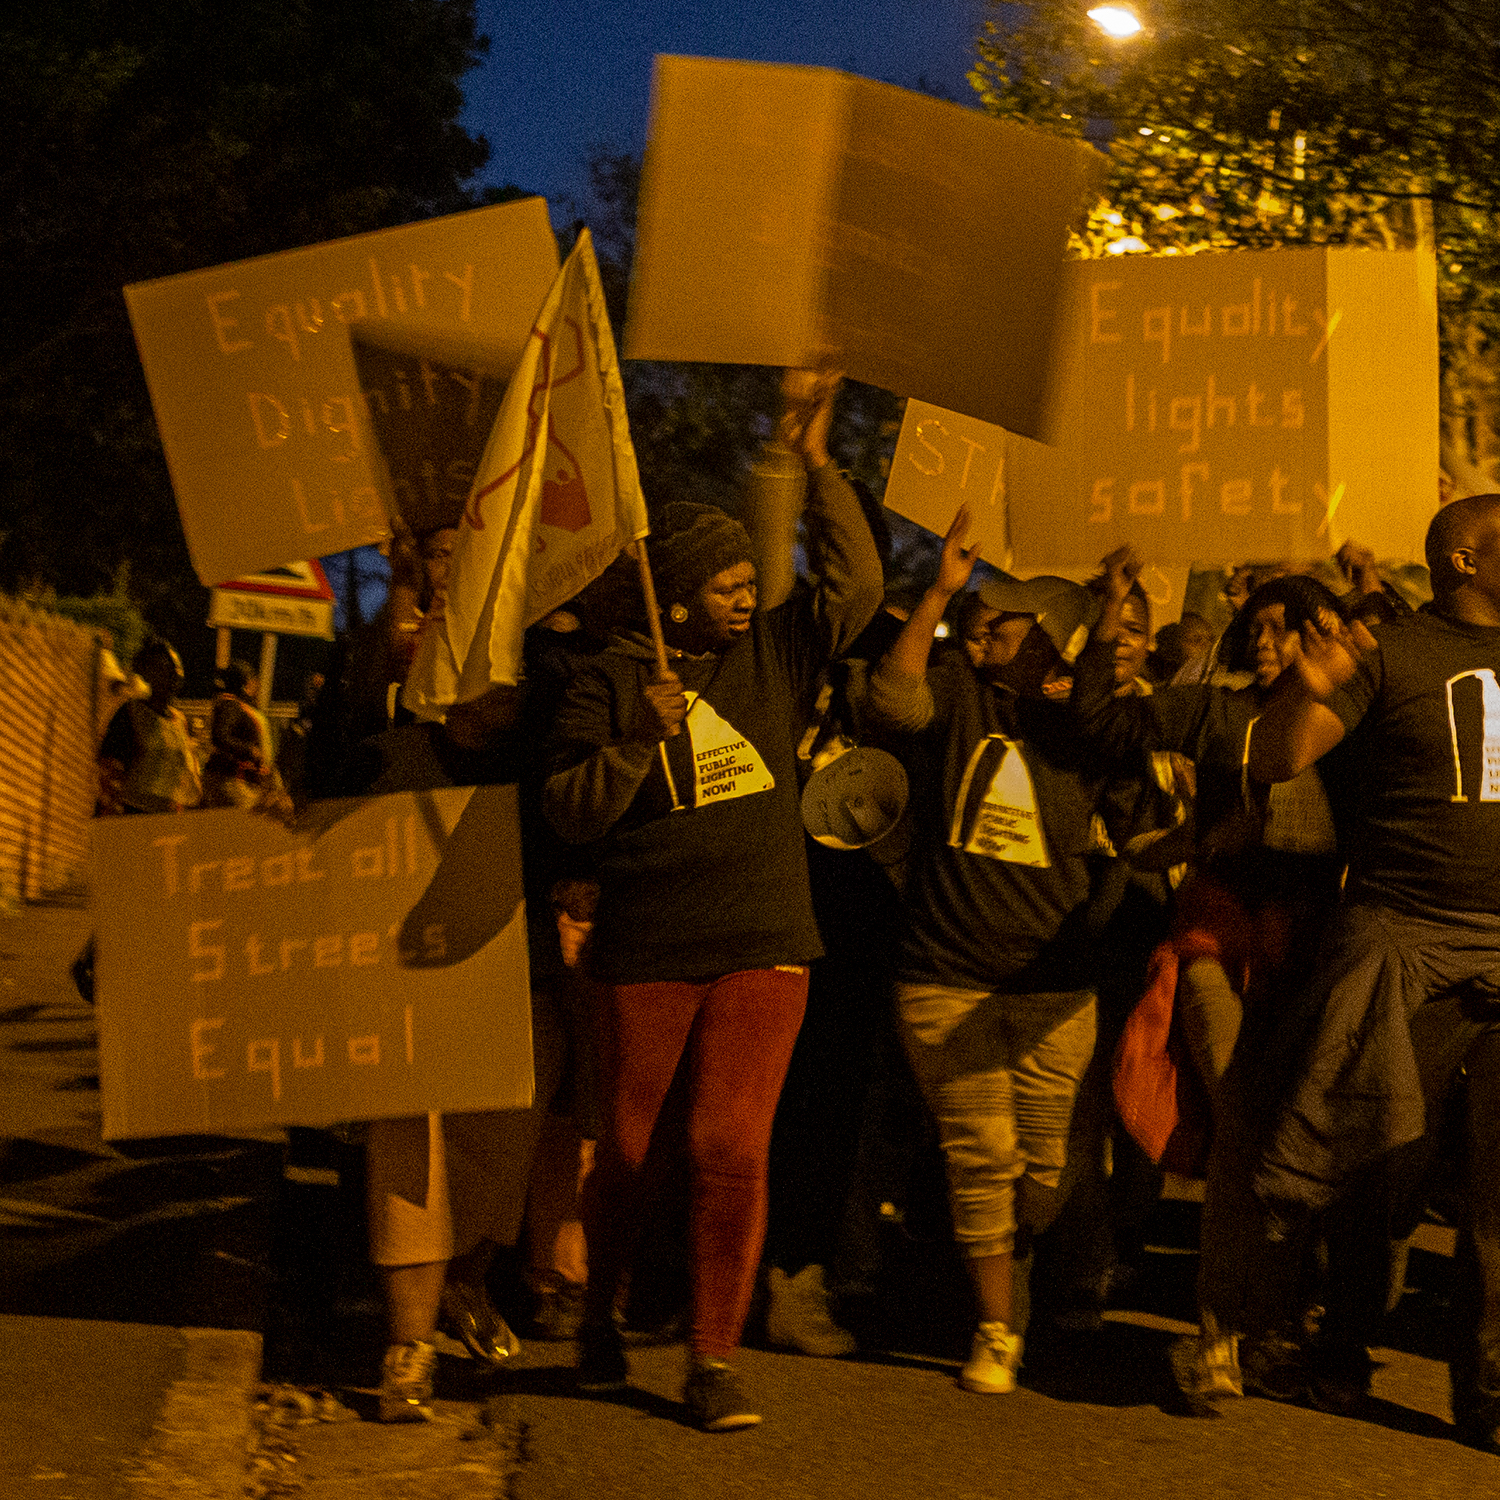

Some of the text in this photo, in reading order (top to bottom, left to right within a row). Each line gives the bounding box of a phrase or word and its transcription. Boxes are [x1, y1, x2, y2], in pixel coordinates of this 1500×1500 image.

[207, 258, 474, 362] Equality
[1091, 276, 1342, 364] Equality
[250, 357, 481, 463] Dignity
[1125, 375, 1305, 452] lights
[908, 418, 1005, 505] ST
[1089, 462, 1346, 538] safety
[696, 741, 747, 762] EFFECTIVE
[698, 756, 736, 773] PUBLIC
[701, 763, 754, 785] LIGHTING
[702, 781, 736, 799] NOW!
[153, 812, 418, 897] Treat all
[190, 919, 448, 982] Streets
[190, 1004, 414, 1101] Equal
